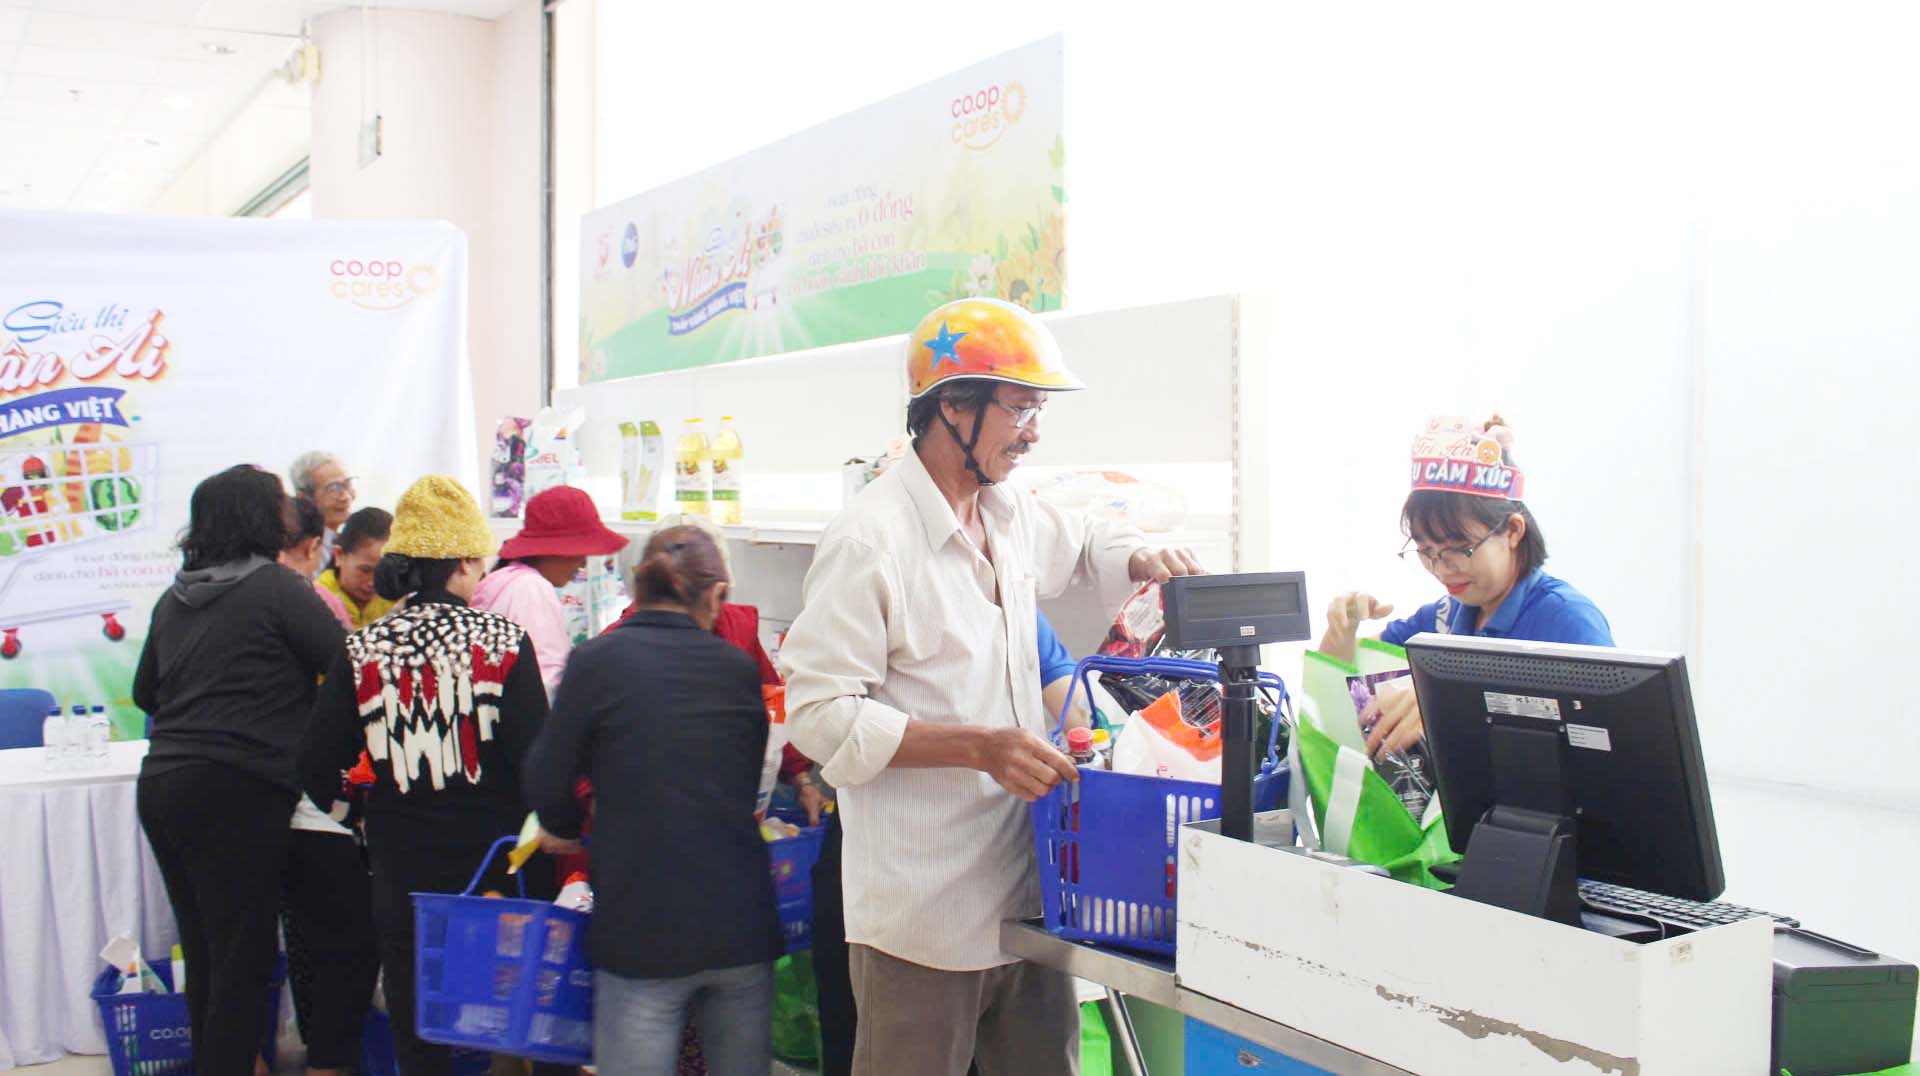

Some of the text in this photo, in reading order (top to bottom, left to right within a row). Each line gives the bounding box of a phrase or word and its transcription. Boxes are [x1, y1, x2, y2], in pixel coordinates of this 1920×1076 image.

[952, 85, 999, 118] co.op
[952, 109, 999, 145] cares
[329, 258, 404, 281] co.op
[329, 279, 404, 301] cares
[3, 301, 131, 342] Siêu thị
[63, 395, 117, 422] VIỆT
[1474, 462, 1512, 487] XÚC
